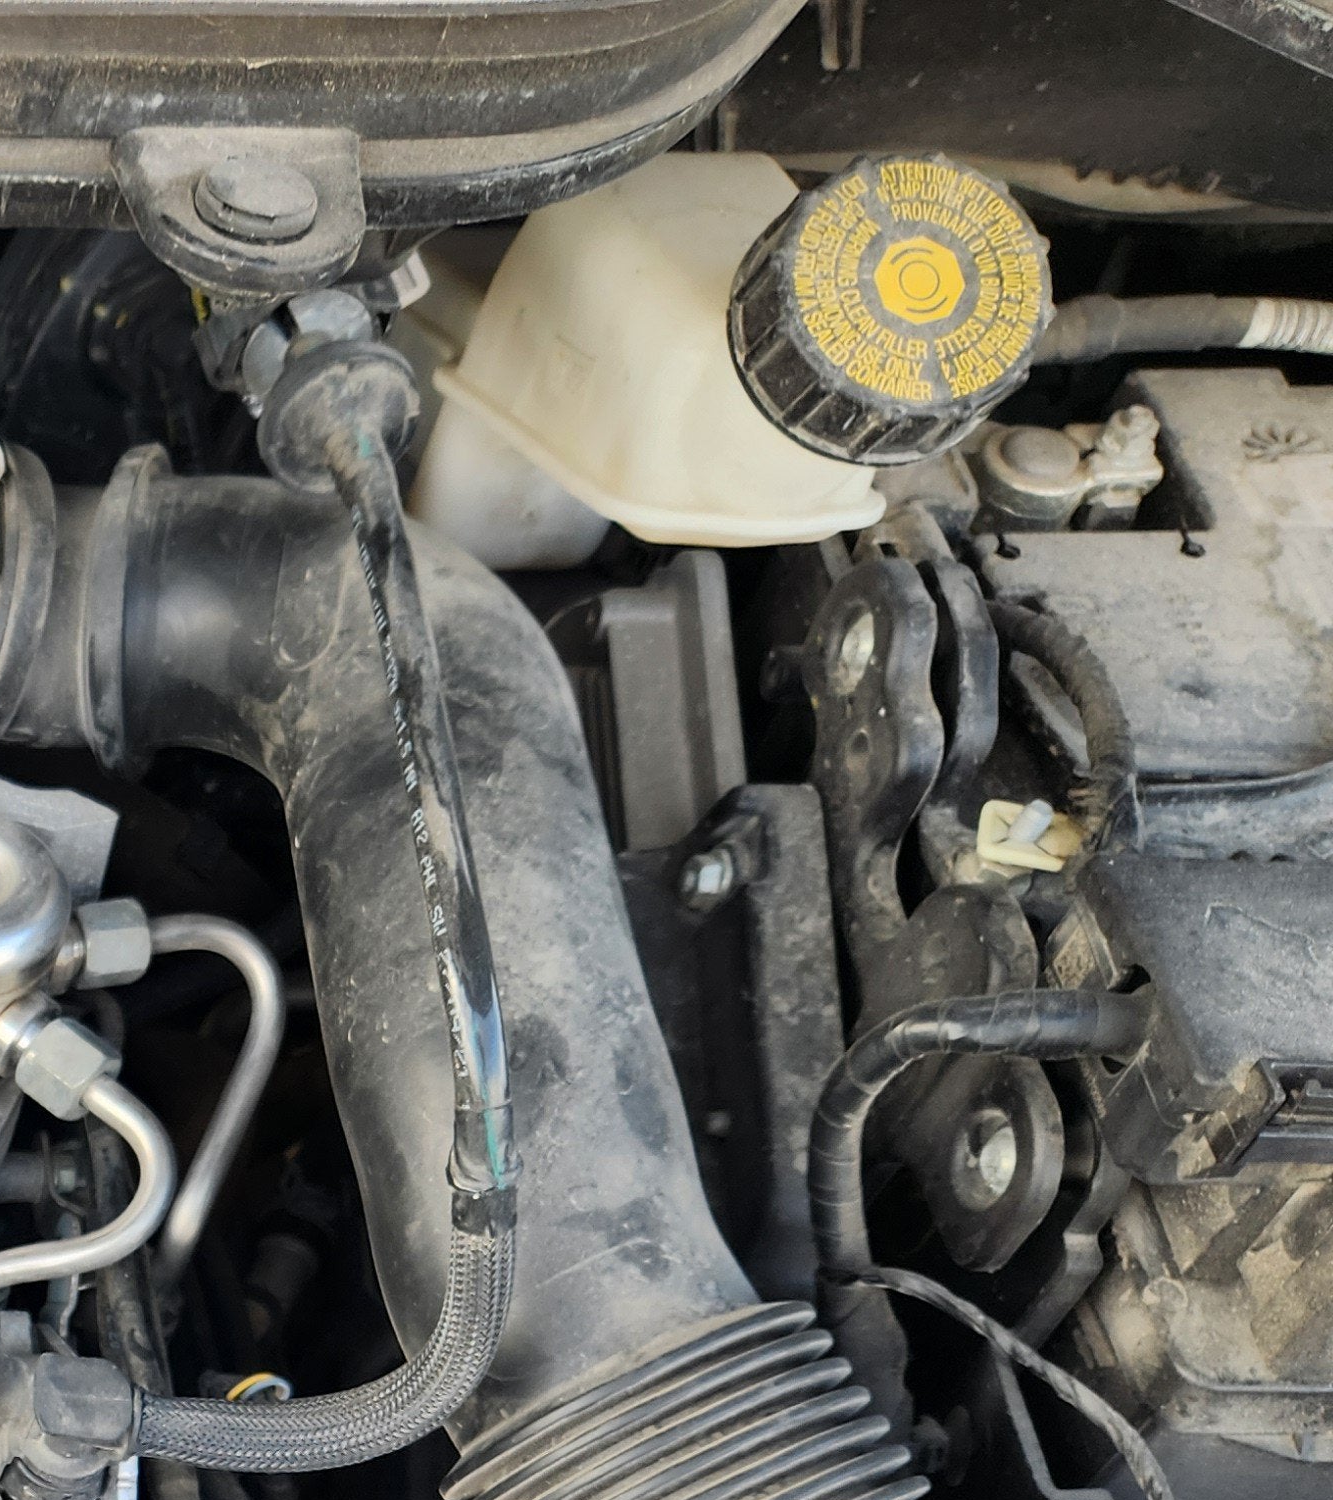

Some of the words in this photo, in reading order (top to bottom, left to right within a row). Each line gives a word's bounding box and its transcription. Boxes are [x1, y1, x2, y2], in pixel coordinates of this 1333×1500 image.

[880, 161, 958, 188] ATTENTION
[958, 176, 1021, 233] NETTOYER
[962, 200, 996, 227] QUE
[891, 200, 977, 239] PROVENANT
[936, 316, 984, 359] SCELLE
[805, 310, 850, 363] SEALED
[847, 358, 930, 399] CONTAINER
[874, 328, 925, 358] FILLER
[883, 356, 920, 381] ONLY
[948, 358, 1002, 399] DEPOSE
